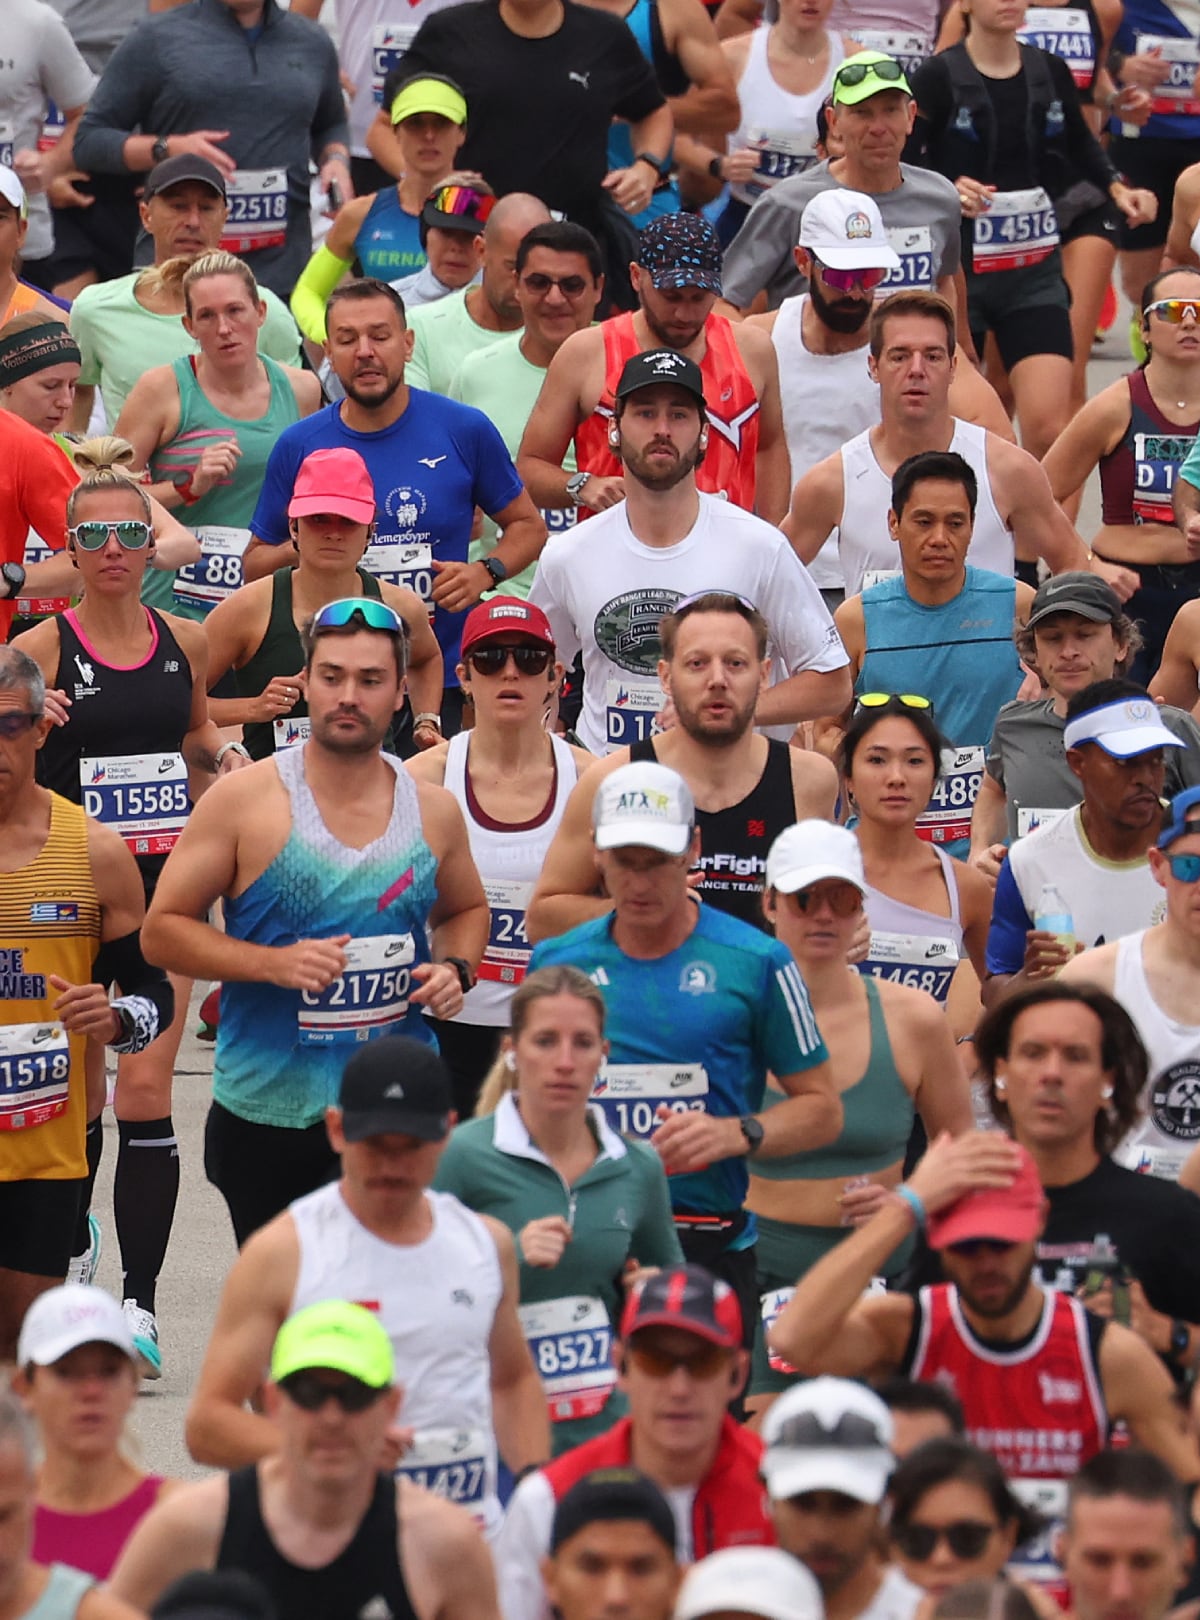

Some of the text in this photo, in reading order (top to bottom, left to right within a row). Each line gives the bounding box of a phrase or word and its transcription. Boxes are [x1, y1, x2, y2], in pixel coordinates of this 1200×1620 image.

[375, 51, 388, 74] C
[976, 211, 1057, 241] D 4516
[1138, 464, 1154, 489] D
[620, 593, 646, 605] RANGER
[609, 711, 625, 738] D
[85, 784, 187, 818] D 15585
[616, 792, 649, 810] ATX
[932, 774, 983, 806] 488
[733, 883, 765, 893] TEAM
[931, 943, 947, 954] RUN
[329, 967, 410, 1006] 21750
[538, 1329, 612, 1374] 8527
